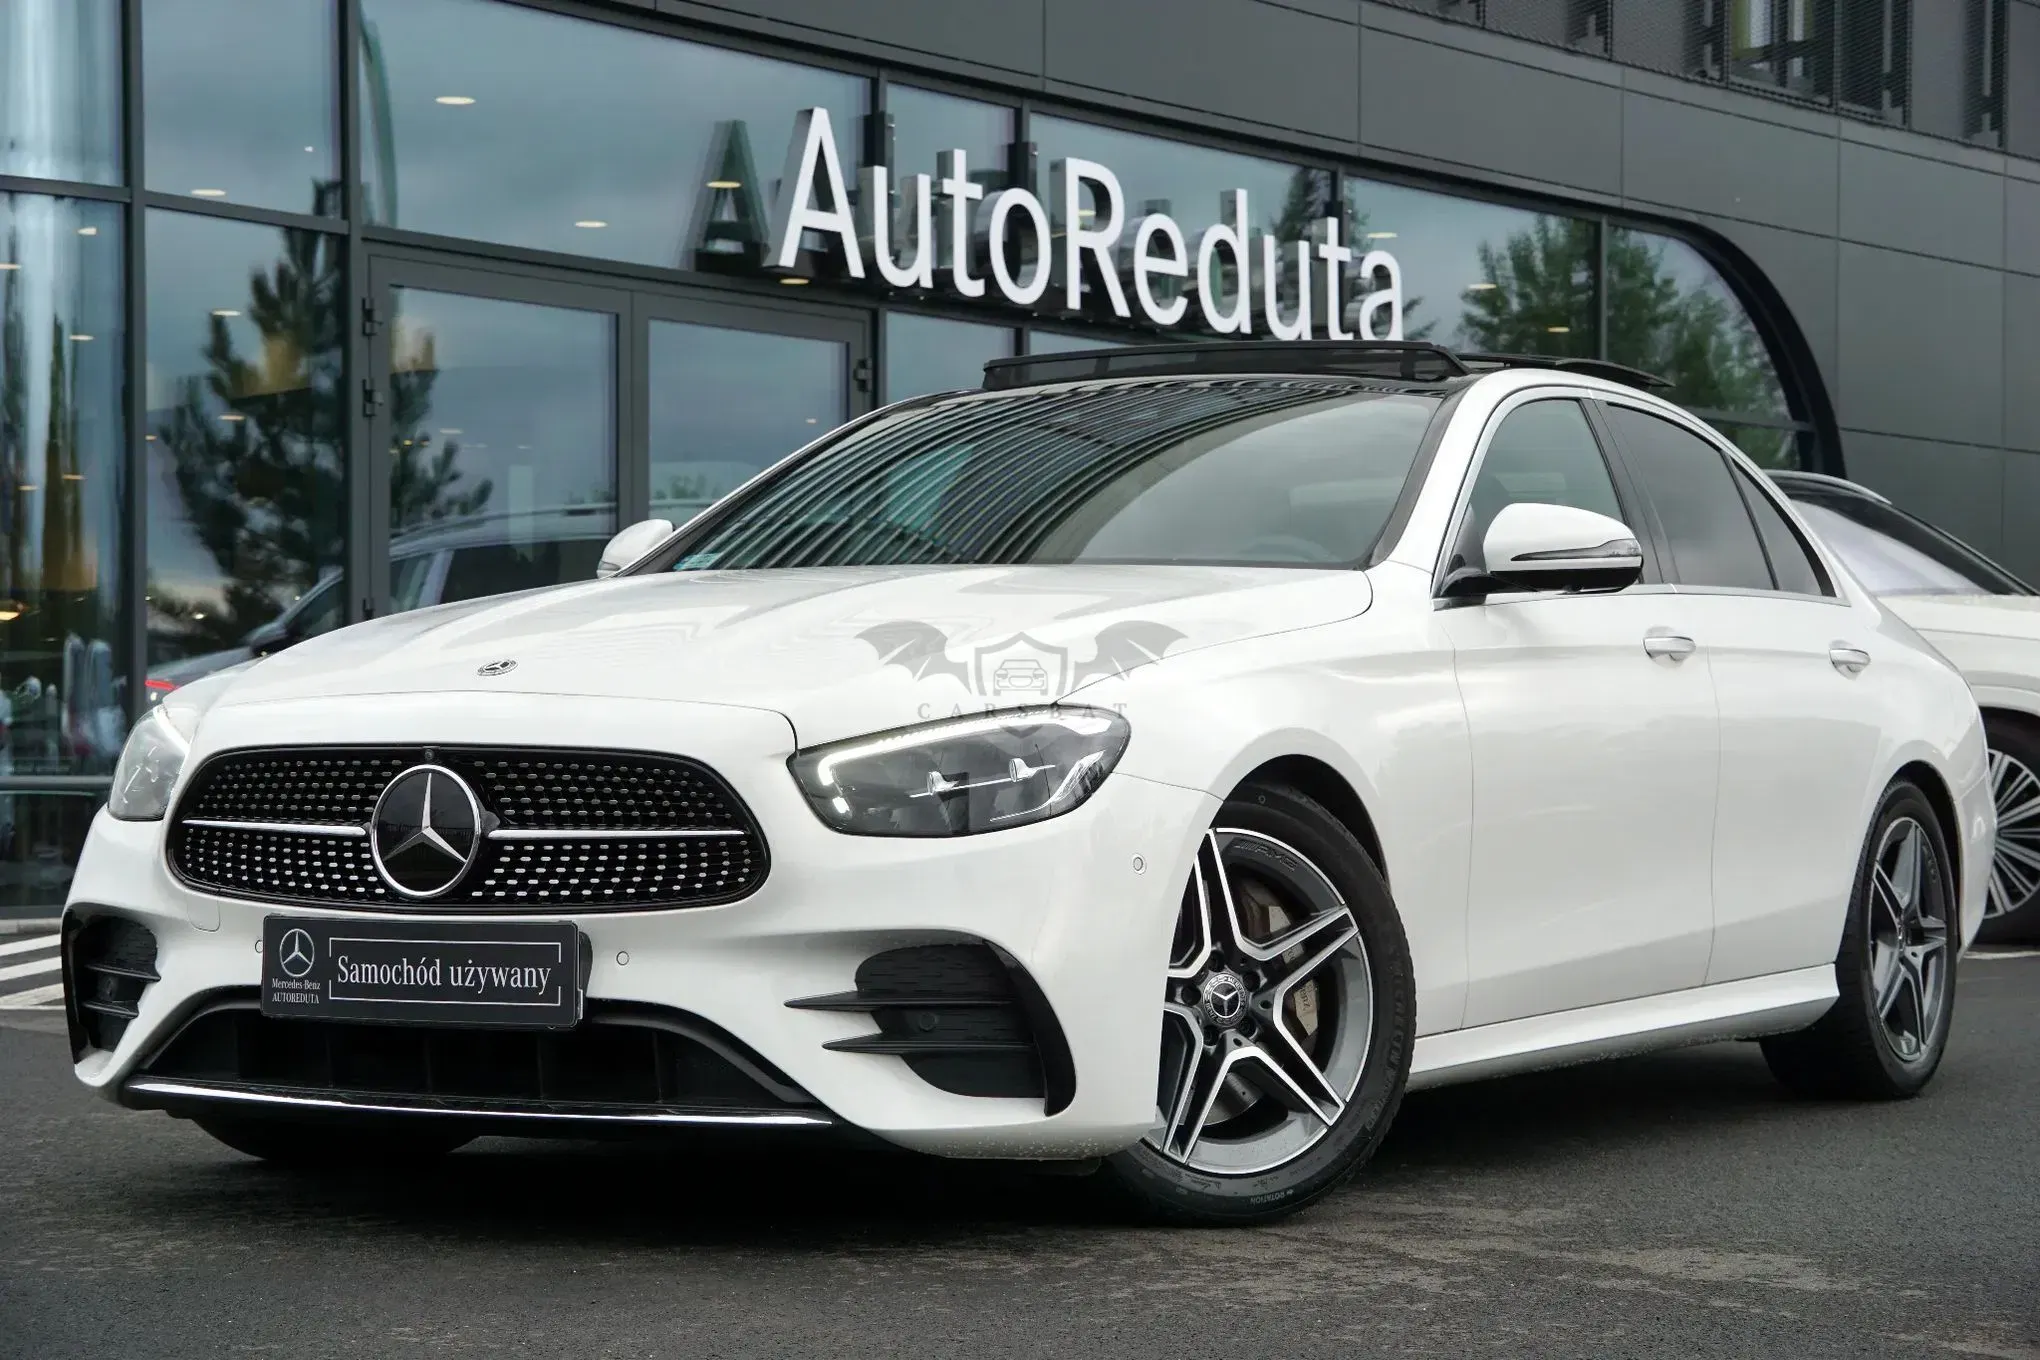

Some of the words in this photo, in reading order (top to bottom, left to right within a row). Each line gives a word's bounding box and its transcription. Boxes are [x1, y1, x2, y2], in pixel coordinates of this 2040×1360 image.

[772, 106, 1403, 341] AutoReduta
[338, 955, 442, 986] Samochód
[449, 959, 551, 996] używany
[271, 977, 321, 990] Mercedes-Benz
[271, 991, 320, 1004] AUTOREDUTA
[1249, 1191, 1286, 1206] ROTATION
